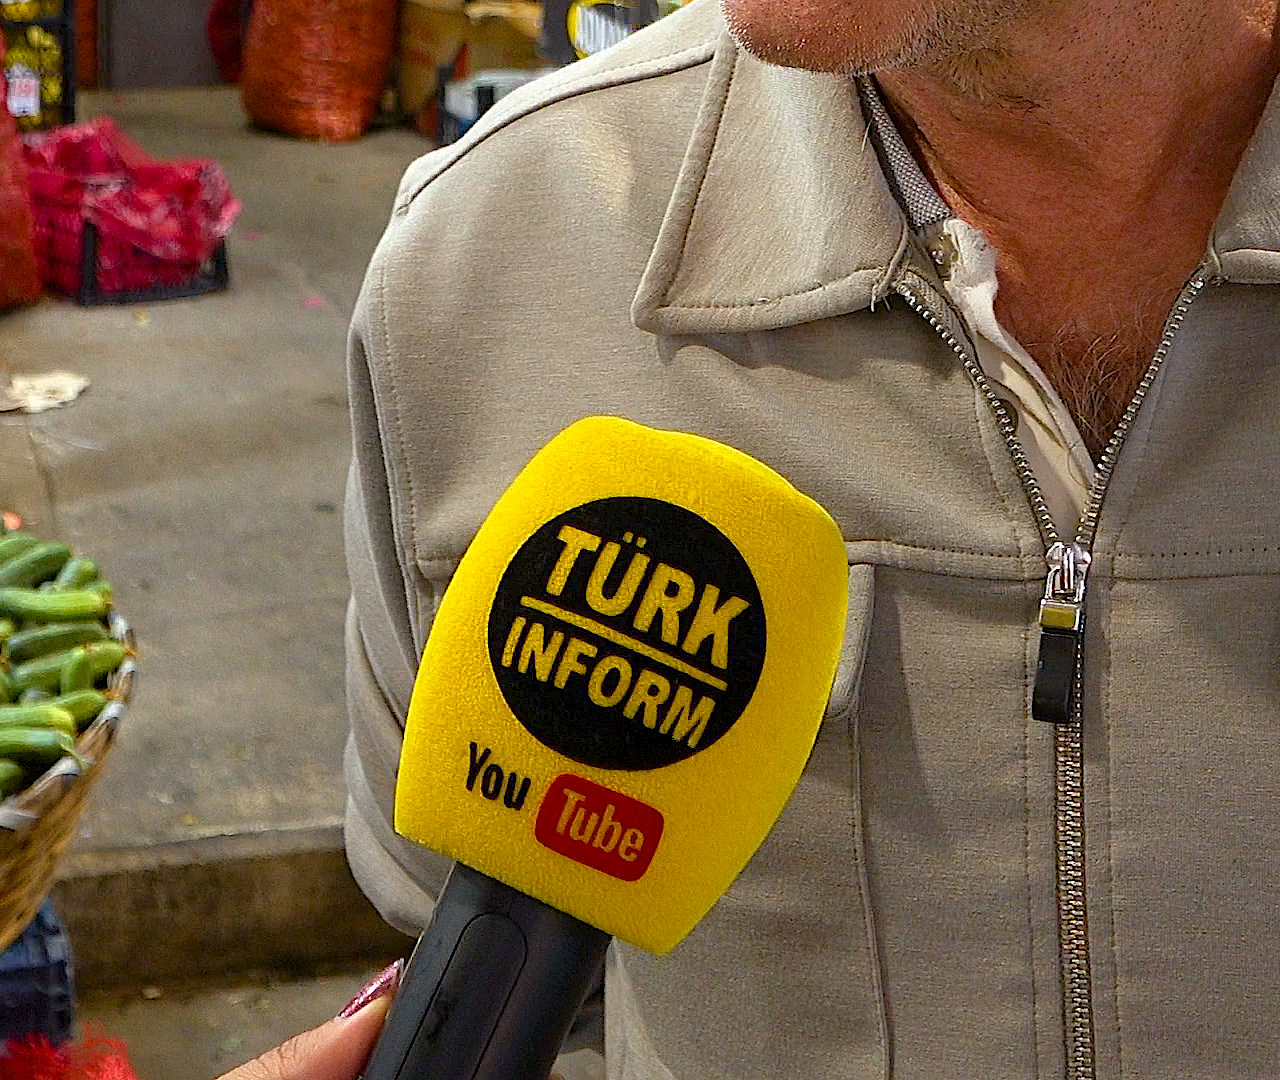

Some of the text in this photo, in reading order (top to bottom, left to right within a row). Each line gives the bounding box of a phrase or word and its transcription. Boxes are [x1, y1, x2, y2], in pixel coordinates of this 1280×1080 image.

[545, 525, 750, 670] TÜRK
[500, 615, 717, 749] INFORM
[464, 741, 646, 862] You Tube
